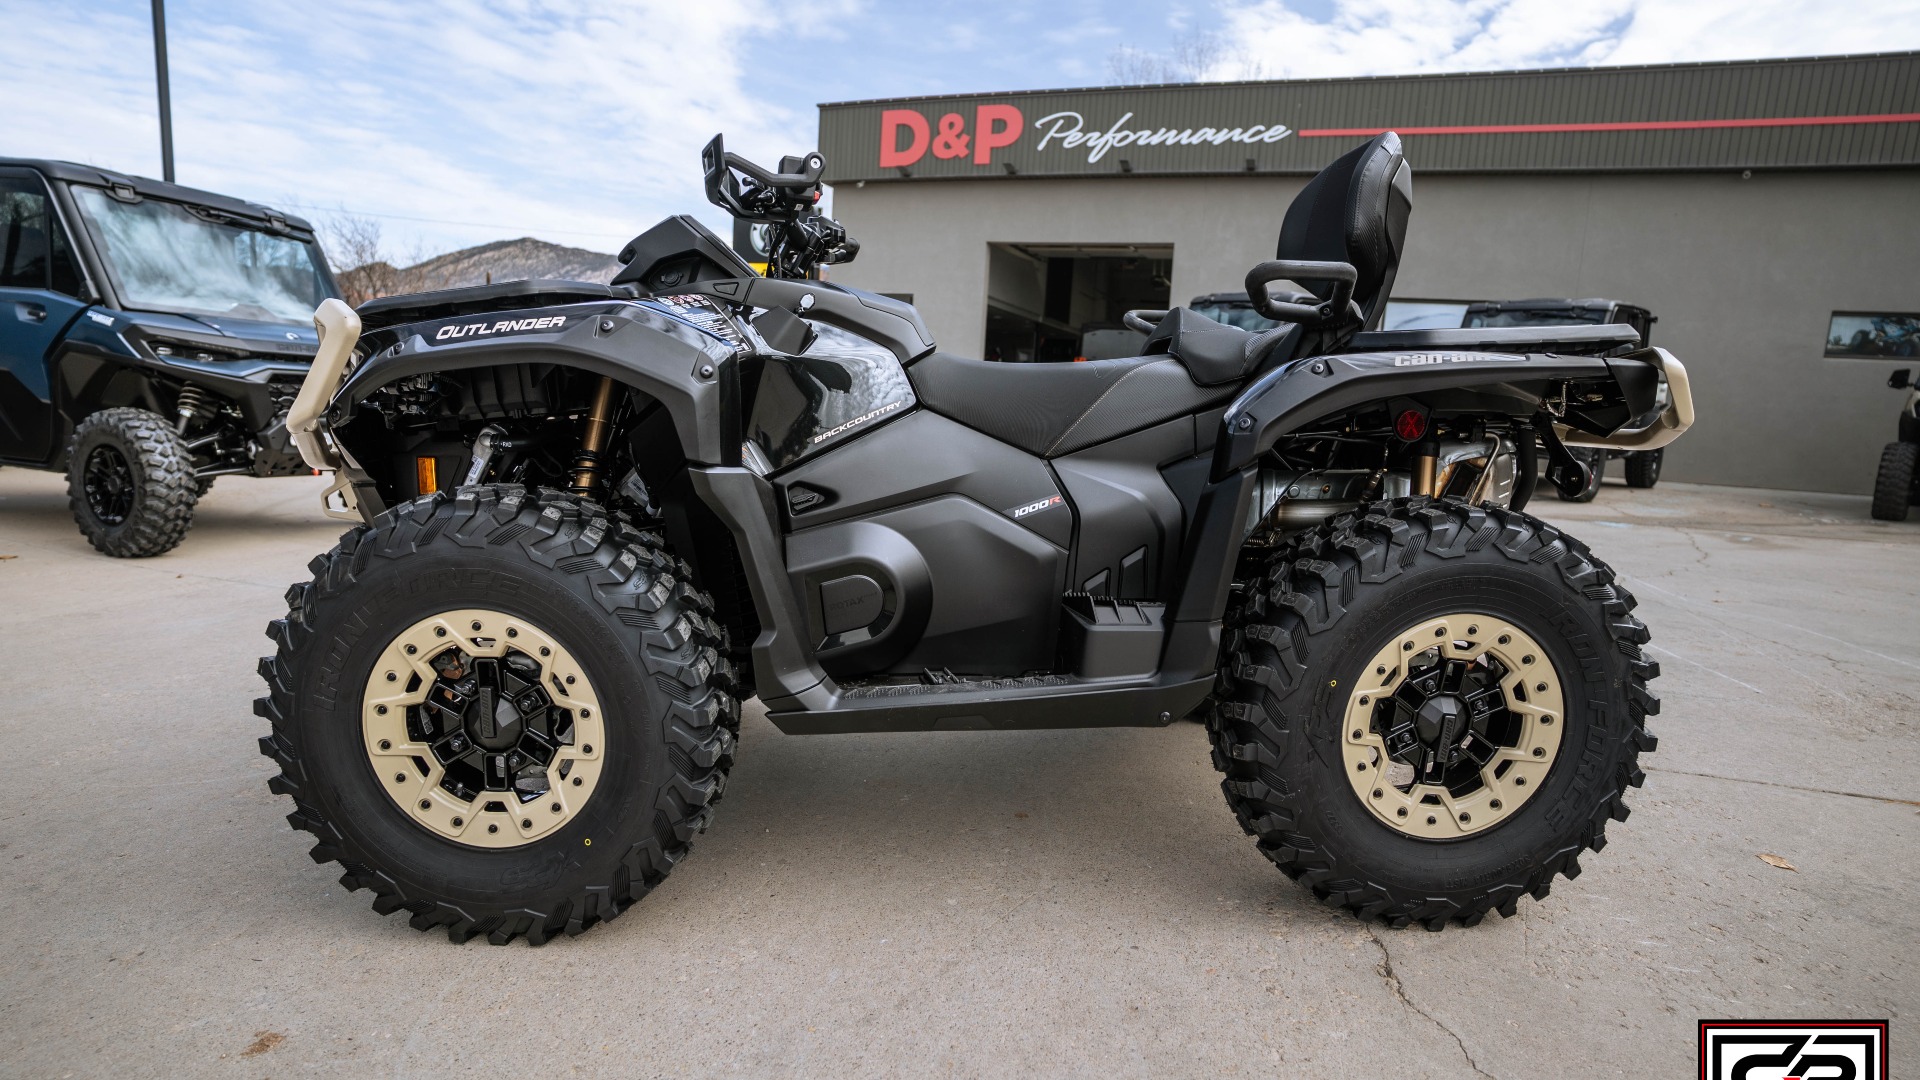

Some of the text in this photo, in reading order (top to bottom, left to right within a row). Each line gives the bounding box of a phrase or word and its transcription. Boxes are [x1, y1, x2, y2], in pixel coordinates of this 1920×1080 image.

[879, 104, 1293, 167] D&P Performance
[435, 315, 567, 340] OUTLANDER
[814, 400, 902, 444] BACKCOUNTRY
[1014, 495, 1062, 518] 1000R
